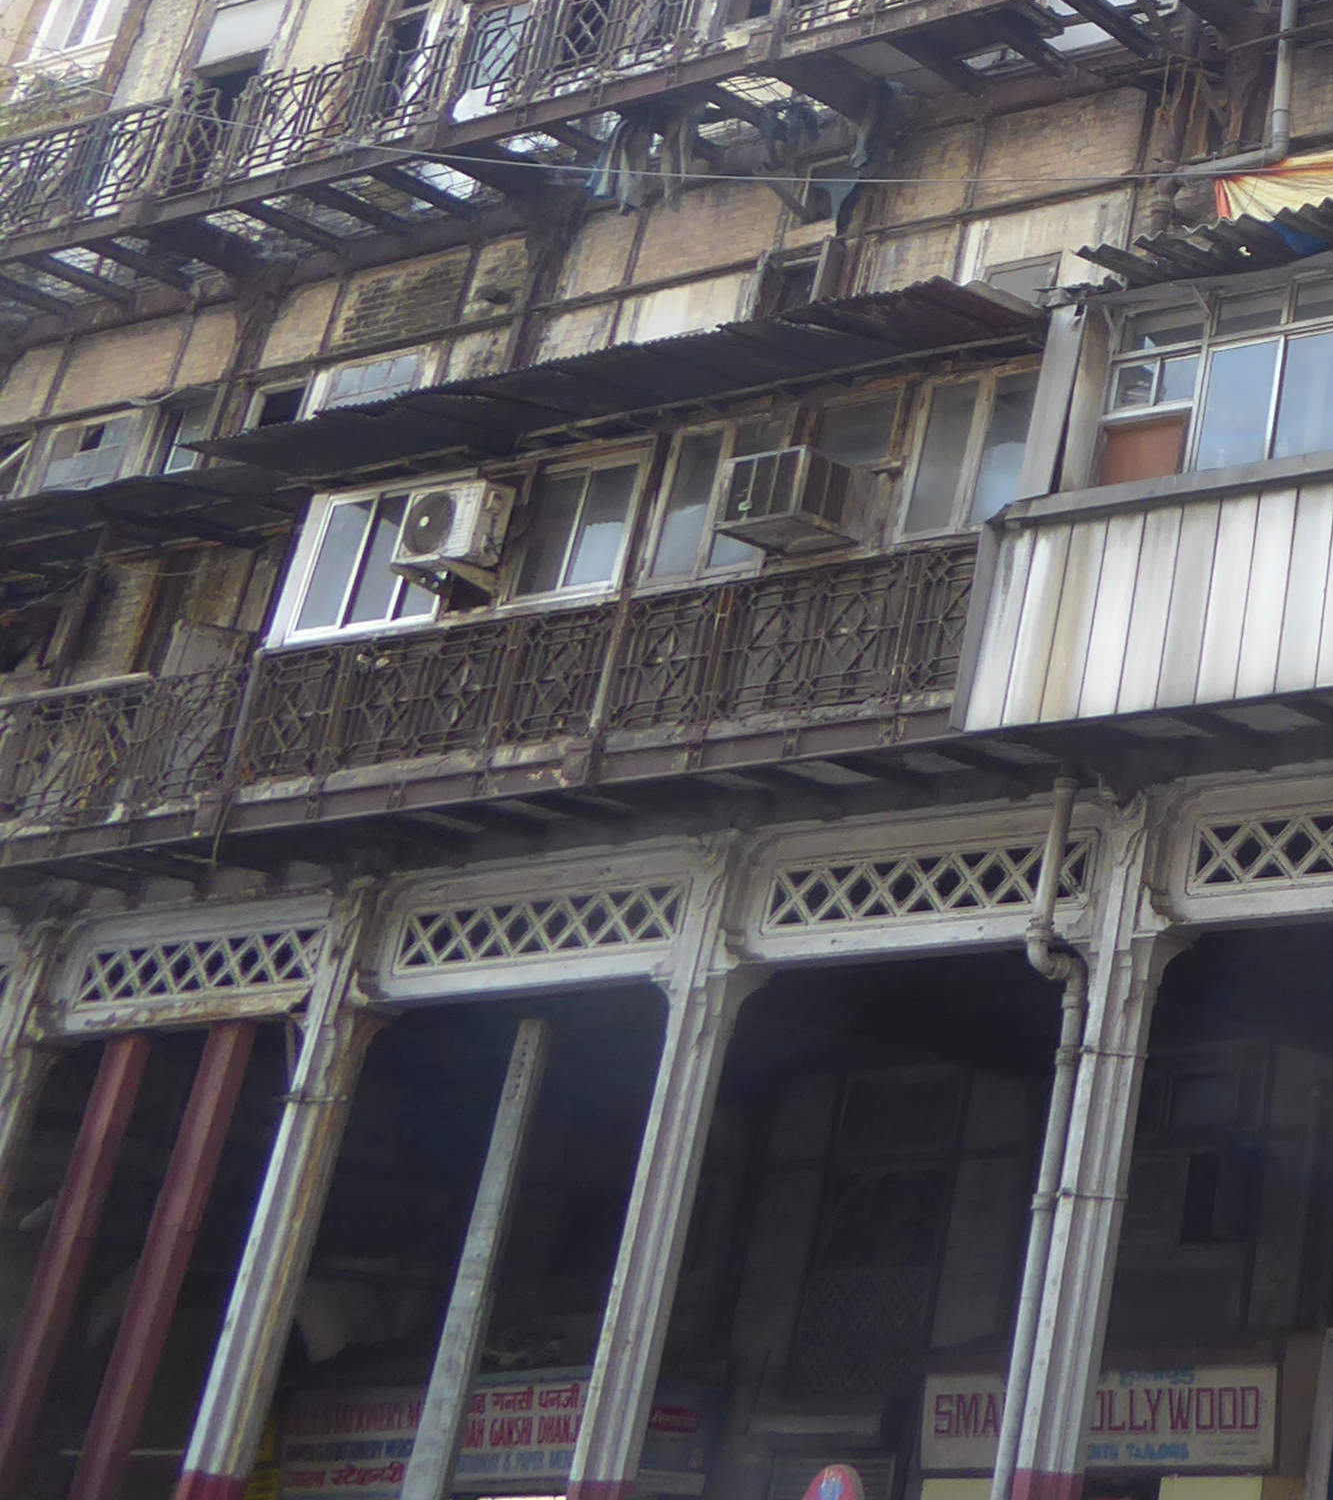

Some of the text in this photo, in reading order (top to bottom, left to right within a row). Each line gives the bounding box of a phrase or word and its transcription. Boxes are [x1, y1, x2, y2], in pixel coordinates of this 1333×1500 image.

[933, 1385, 1260, 1436] SMA OLLYWOOD
[464, 1417, 485, 1449] AH
